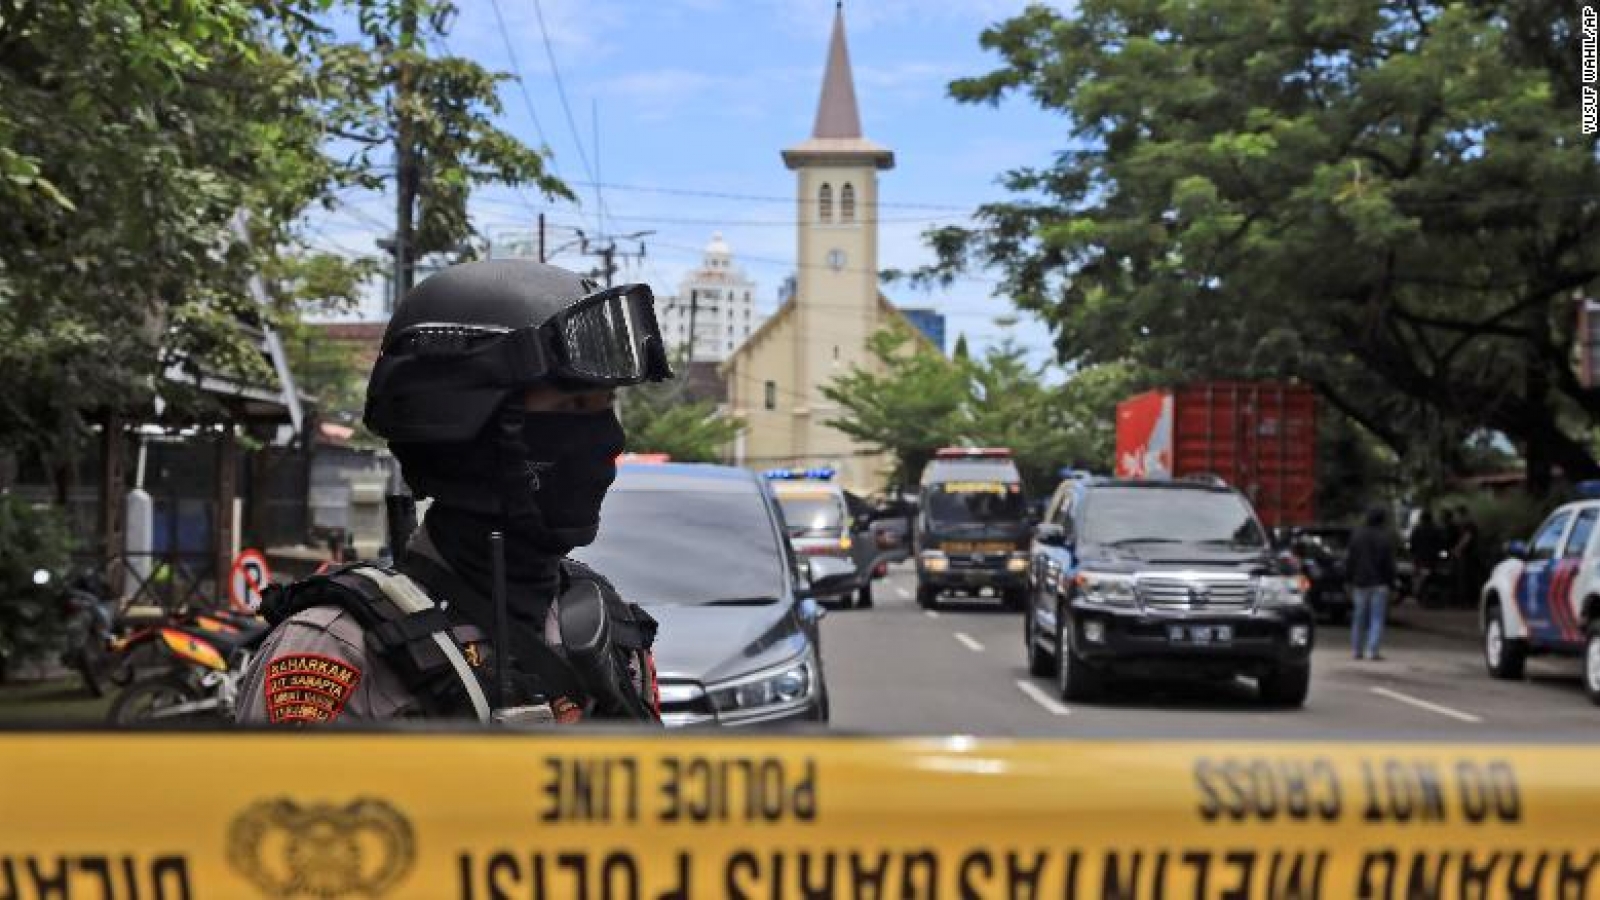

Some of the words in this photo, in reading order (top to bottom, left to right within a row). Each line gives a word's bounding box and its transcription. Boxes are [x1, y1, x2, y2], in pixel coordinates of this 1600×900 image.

[540, 755, 637, 823] LINE
[657, 755, 818, 823] POLICE
[1195, 758, 1342, 822] CROSS
[1361, 759, 1446, 823] NOT
[1455, 761, 1522, 823] DO
[458, 851, 691, 900] POLISI
